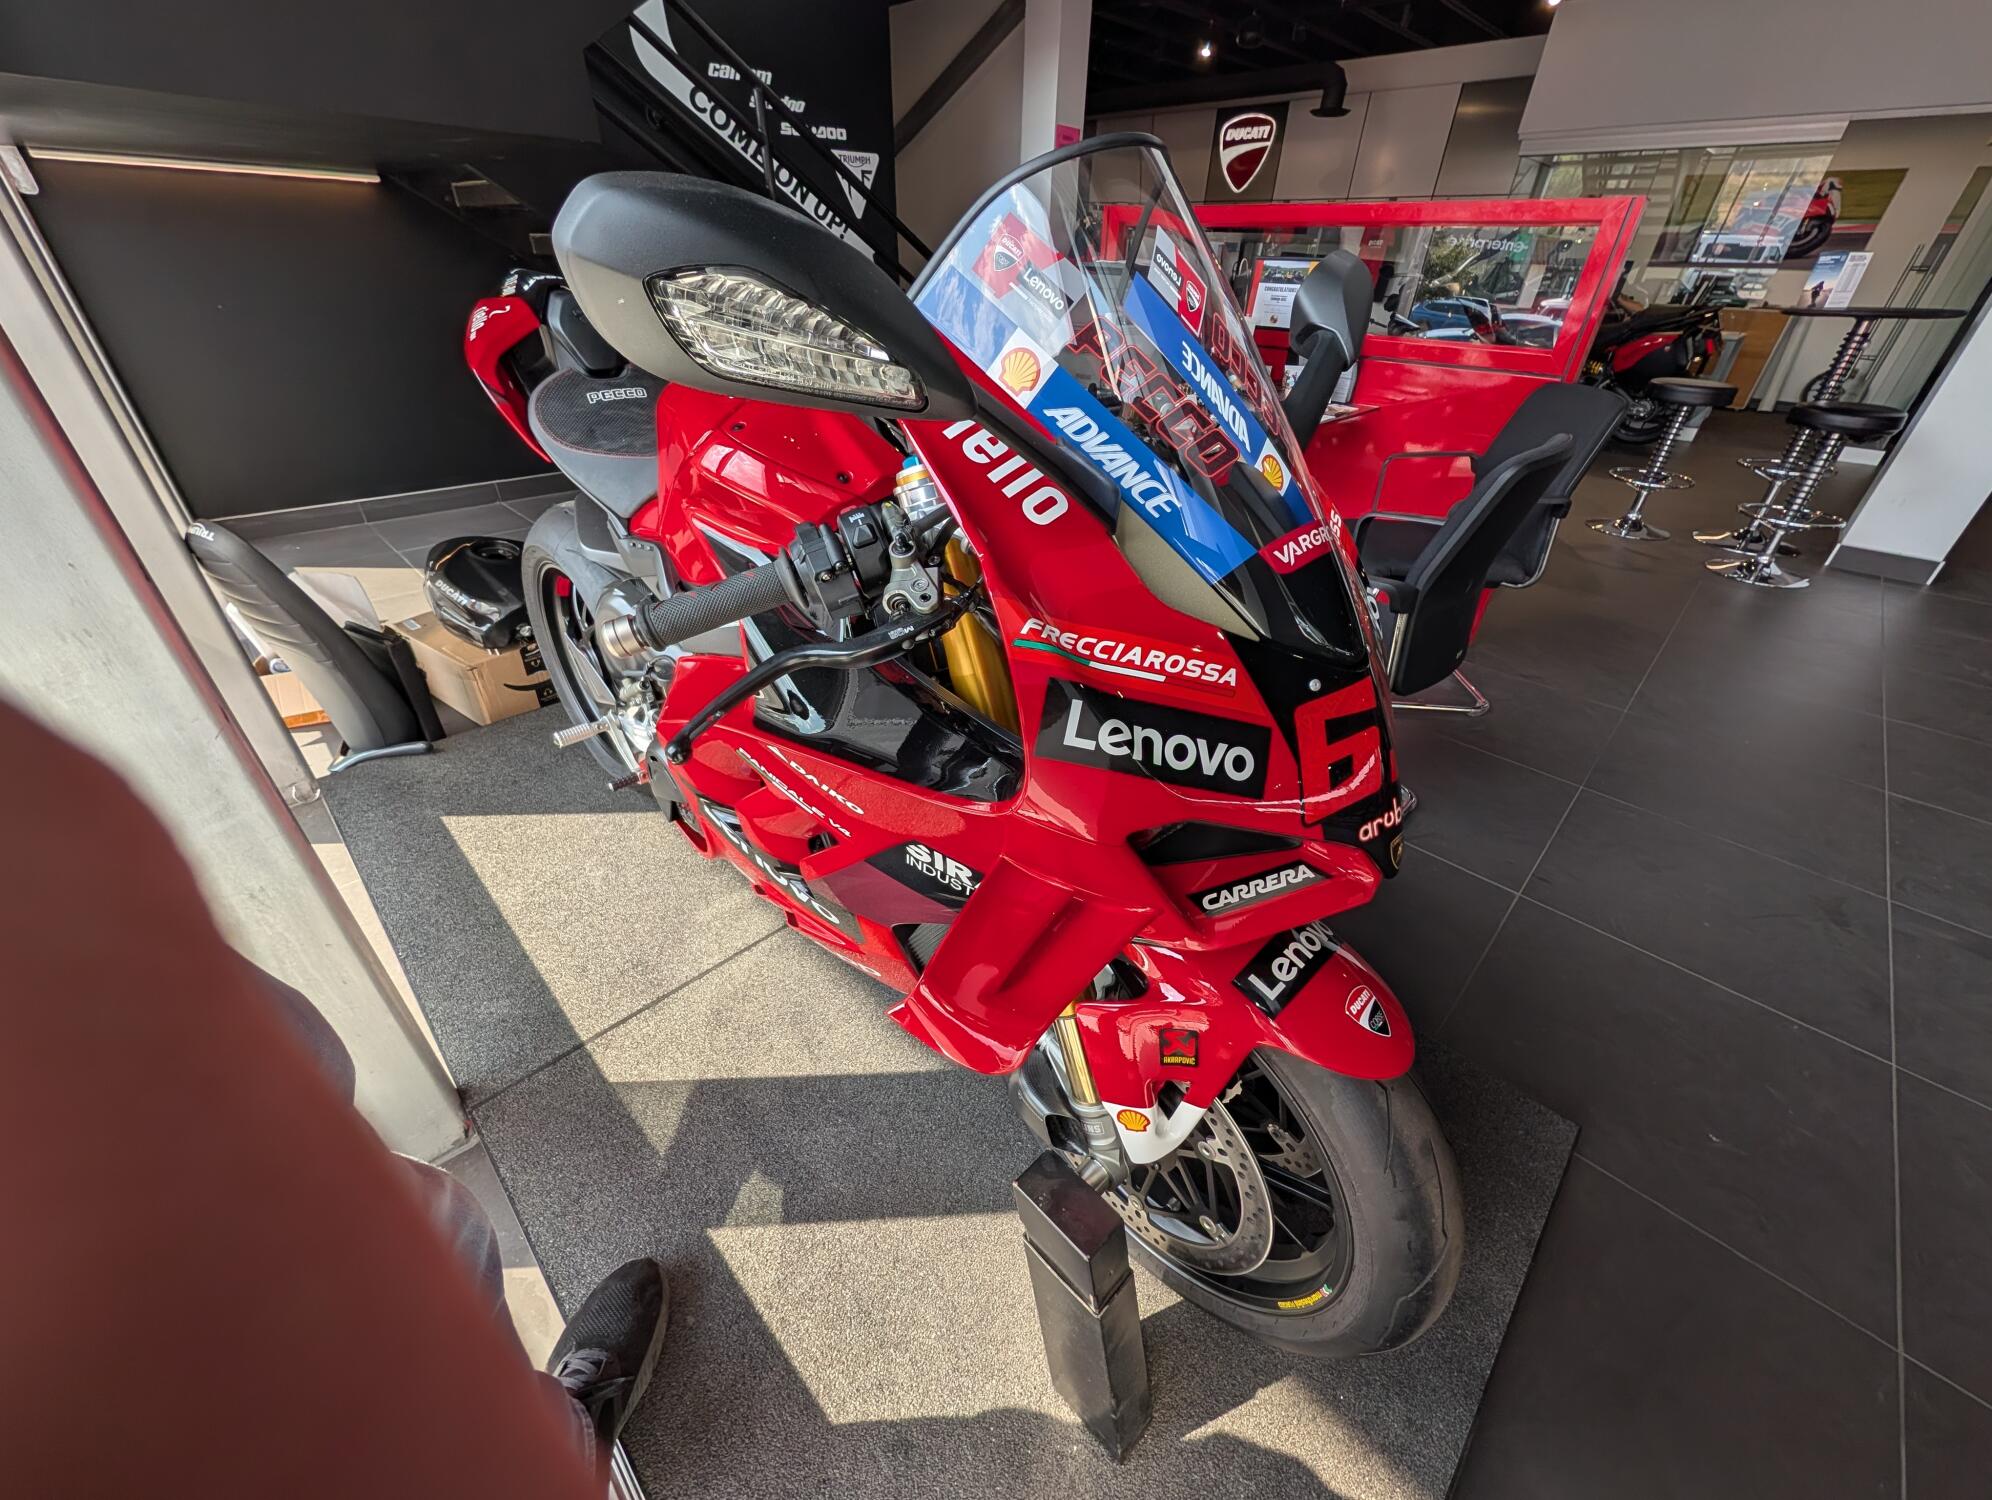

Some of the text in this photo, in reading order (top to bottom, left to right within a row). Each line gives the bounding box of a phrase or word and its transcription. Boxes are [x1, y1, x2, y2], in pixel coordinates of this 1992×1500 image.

[1225, 125, 1271, 142] DUCATI
[838, 154, 871, 167] TRIUMPH
[772, 156, 808, 203] ON
[812, 196, 849, 241] UP!
[1001, 236, 1023, 259] DUCATI
[1023, 267, 1065, 311] Lenovo
[587, 387, 648, 404] PECCO
[1042, 407, 1182, 519] ADVANCE
[434, 579, 468, 605] DUCATI
[1020, 618, 1237, 687] FRECCIAROSSA
[1063, 699, 1255, 782] Lenovo
[906, 844, 973, 887] SIR
[906, 853, 982, 896] INDUST
[1202, 863, 1316, 911] CARRERA
[1350, 989, 1371, 1015] DUCATI
